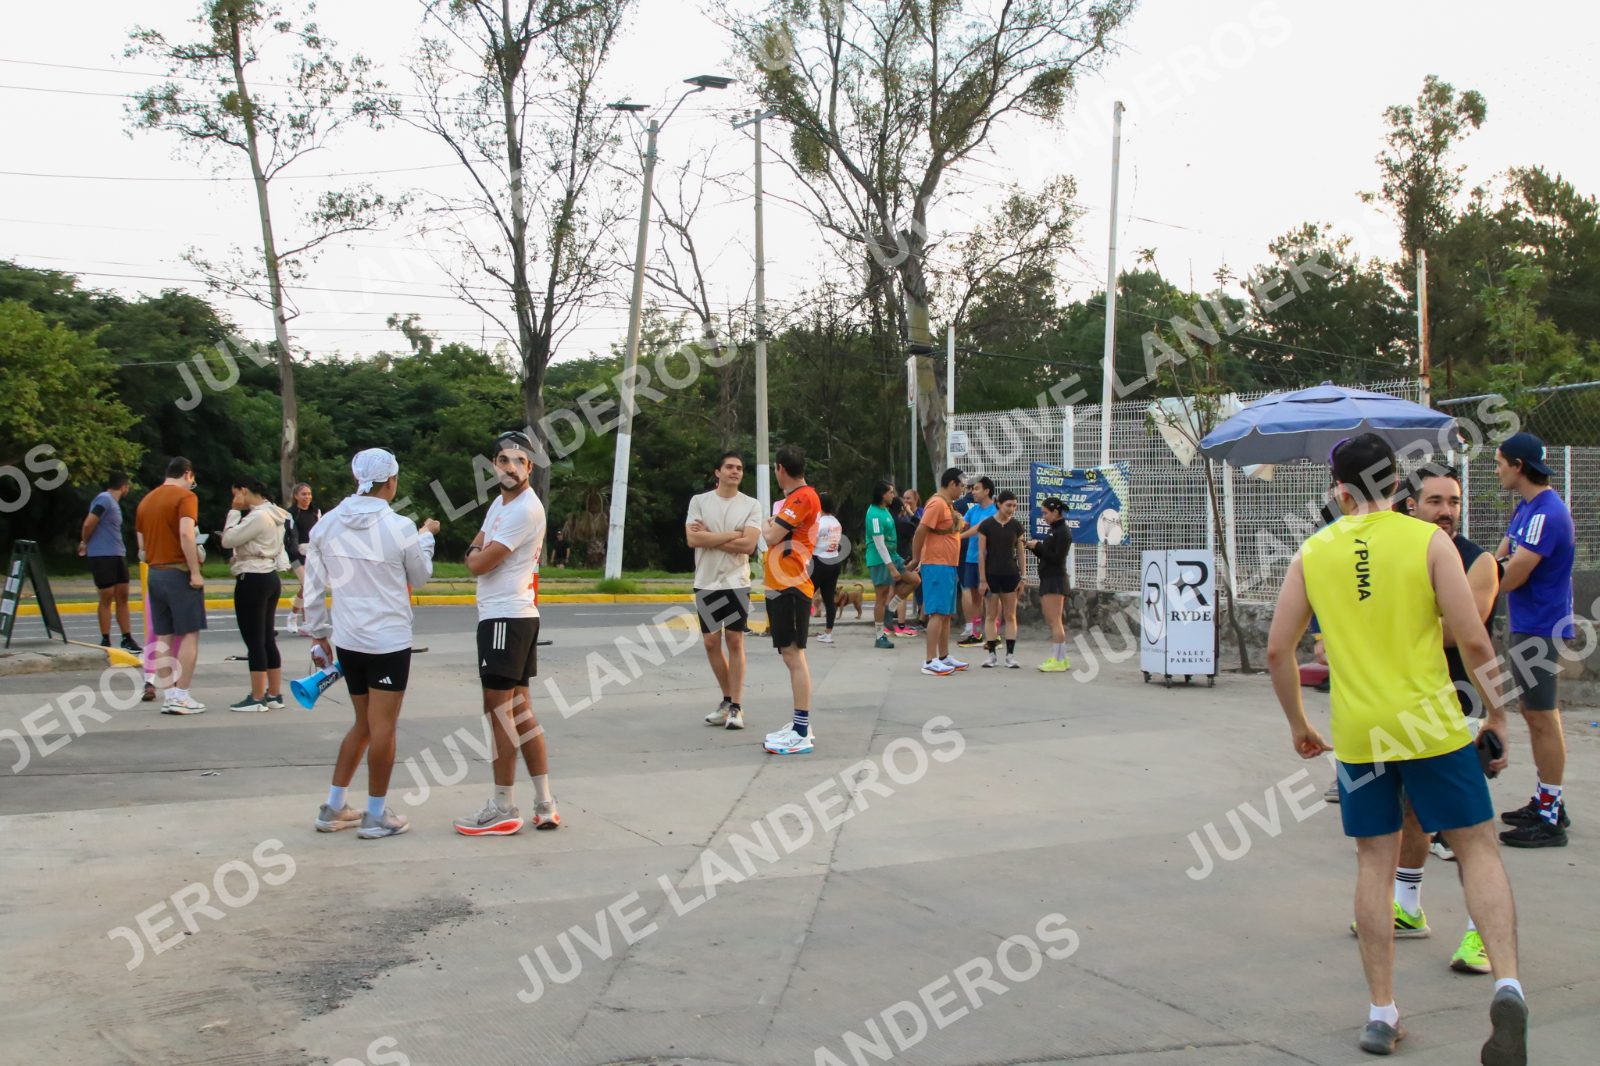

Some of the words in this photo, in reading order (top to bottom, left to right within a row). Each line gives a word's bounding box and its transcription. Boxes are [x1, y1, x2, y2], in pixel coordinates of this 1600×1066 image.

[1036, 476, 1064, 486] VERANO
[1069, 494, 1087, 502] JULIO
[1354, 549, 1371, 602] PUMA
[1171, 611, 1211, 621] RYDE
